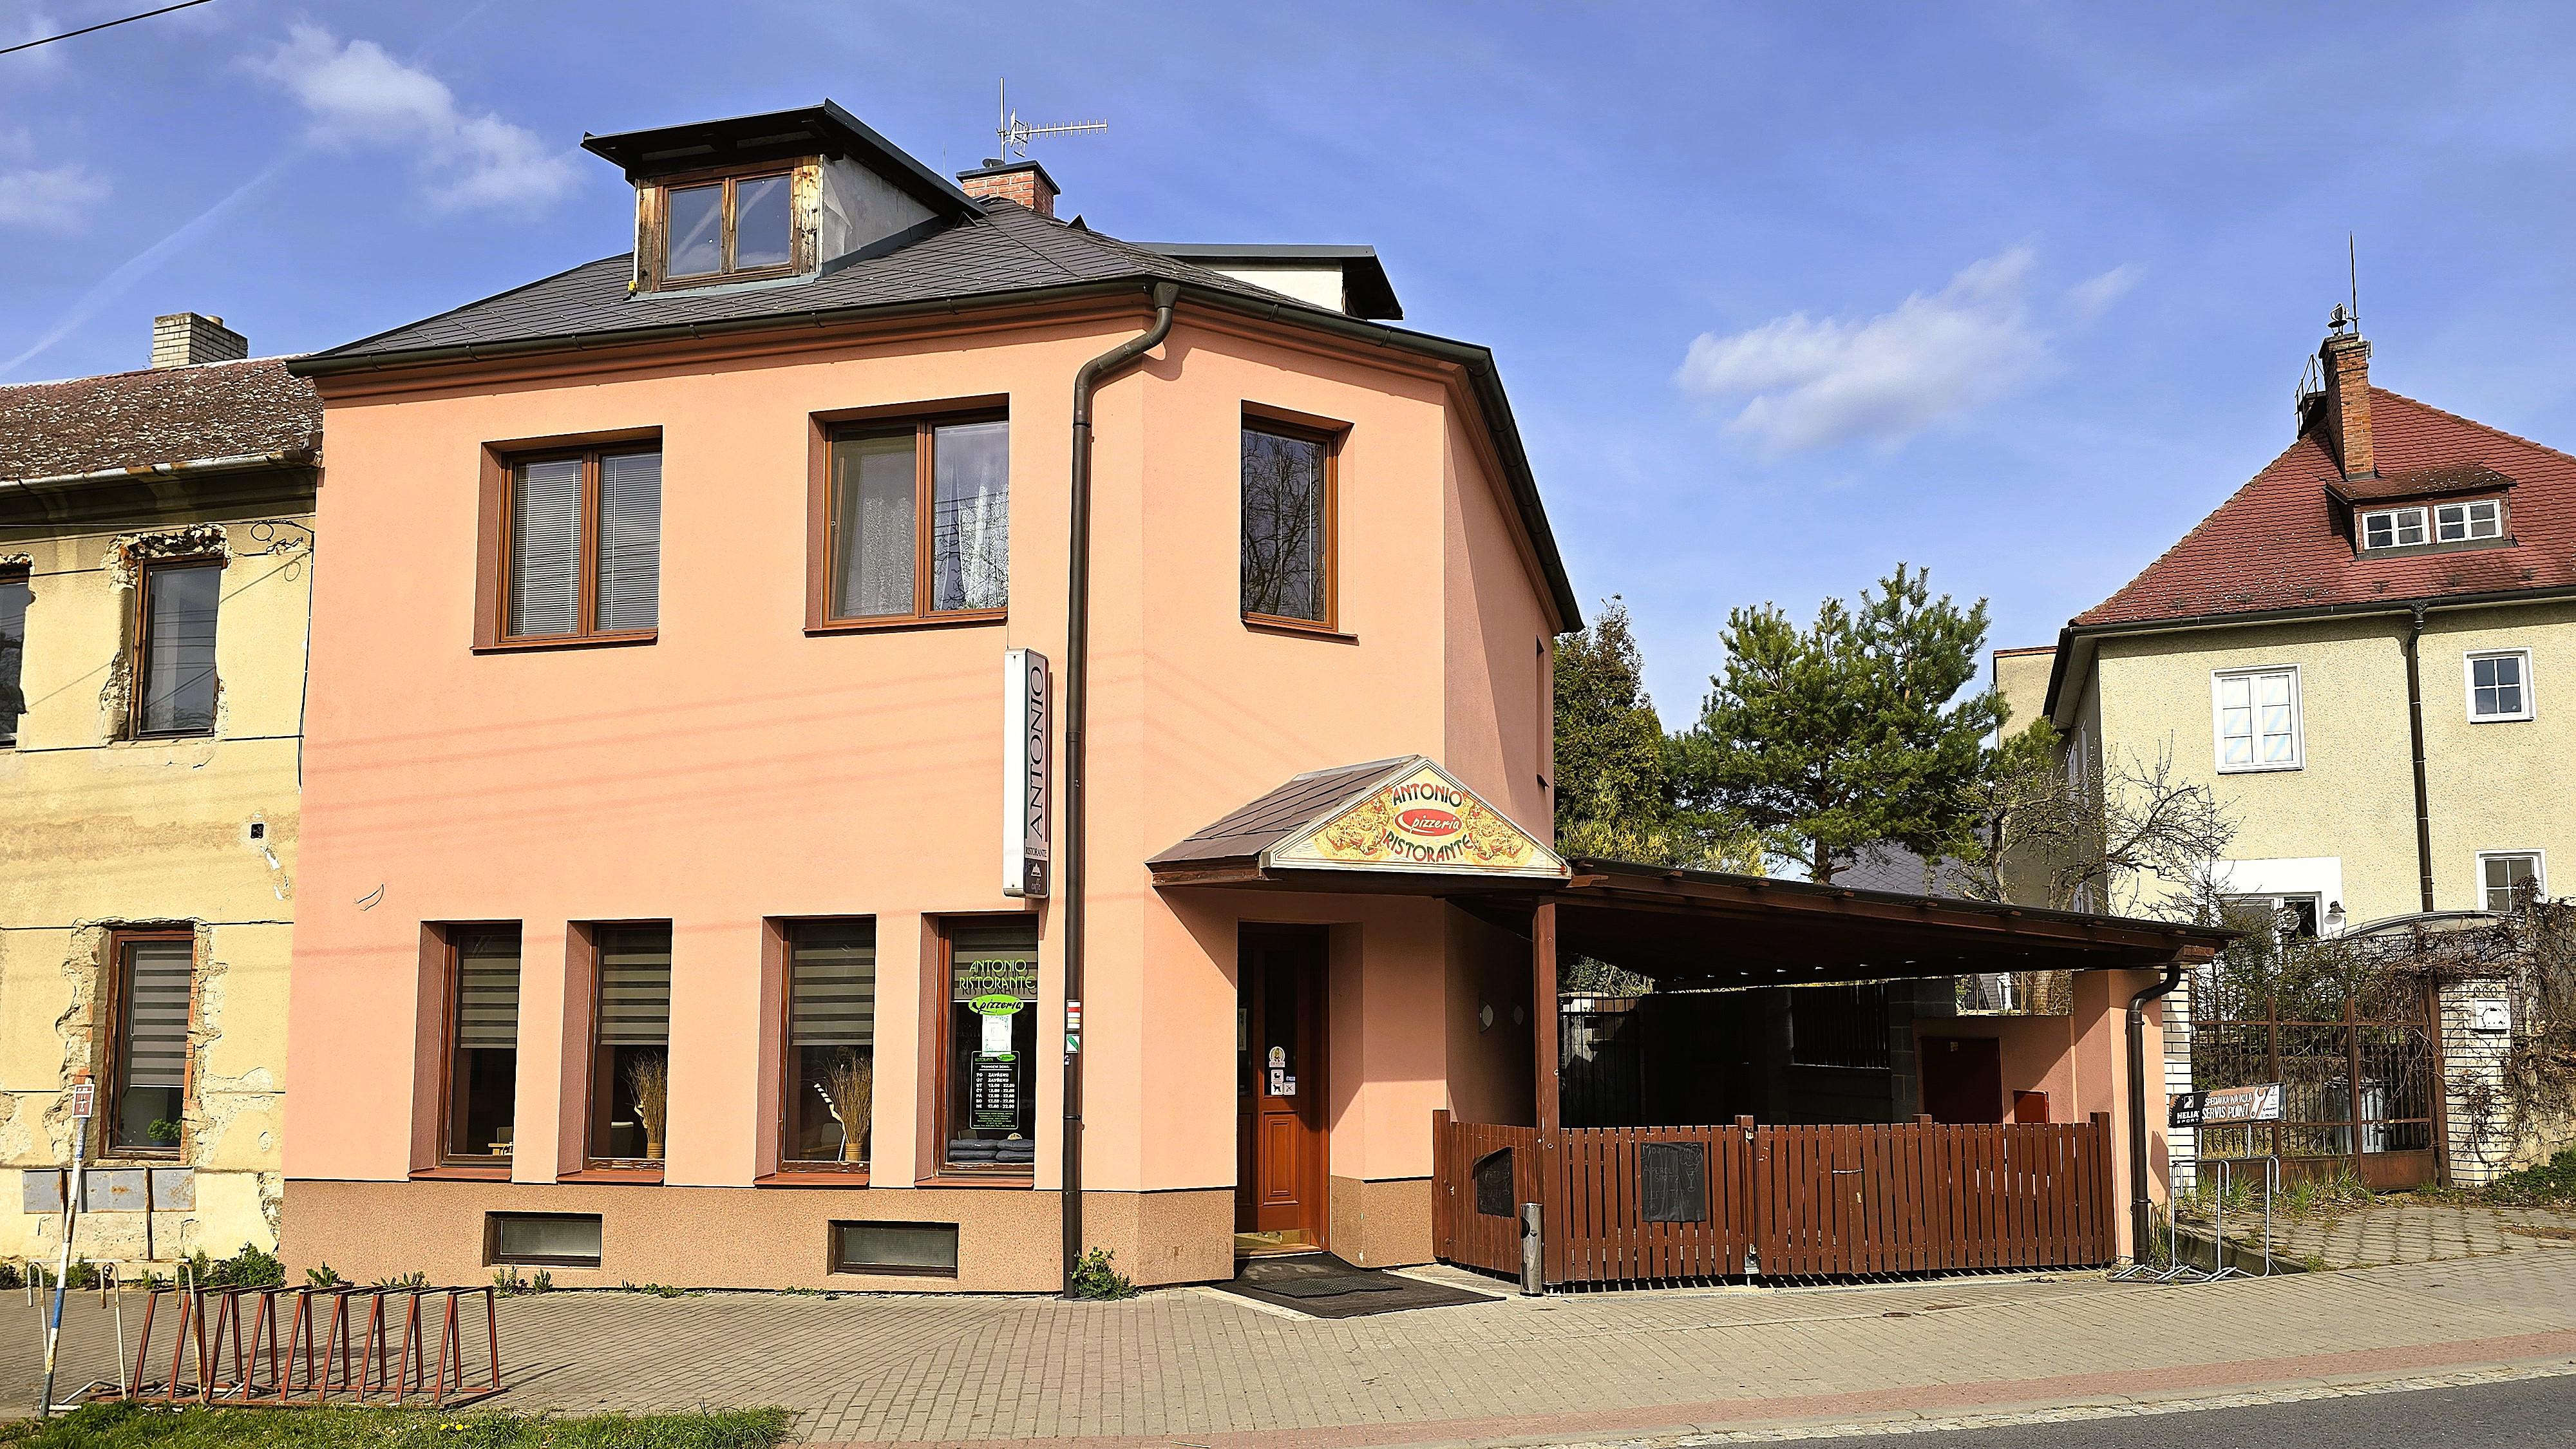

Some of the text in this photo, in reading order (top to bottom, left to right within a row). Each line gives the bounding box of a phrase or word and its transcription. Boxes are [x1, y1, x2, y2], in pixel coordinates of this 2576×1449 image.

[1030, 666, 1043, 841] ANTONIO
[1393, 782, 1463, 808] ANTONIO
[1410, 815, 1459, 833] pizzeria
[1383, 830, 1473, 863] RISTORANTE
[969, 959, 1027, 972] ANTONIO
[959, 976, 1036, 990] RISTORANTE
[979, 998, 1021, 1011] pizzeria
[2202, 1103, 2250, 1120] SERVIS POINT
[1642, 1144, 1674, 1157] MOJITO
